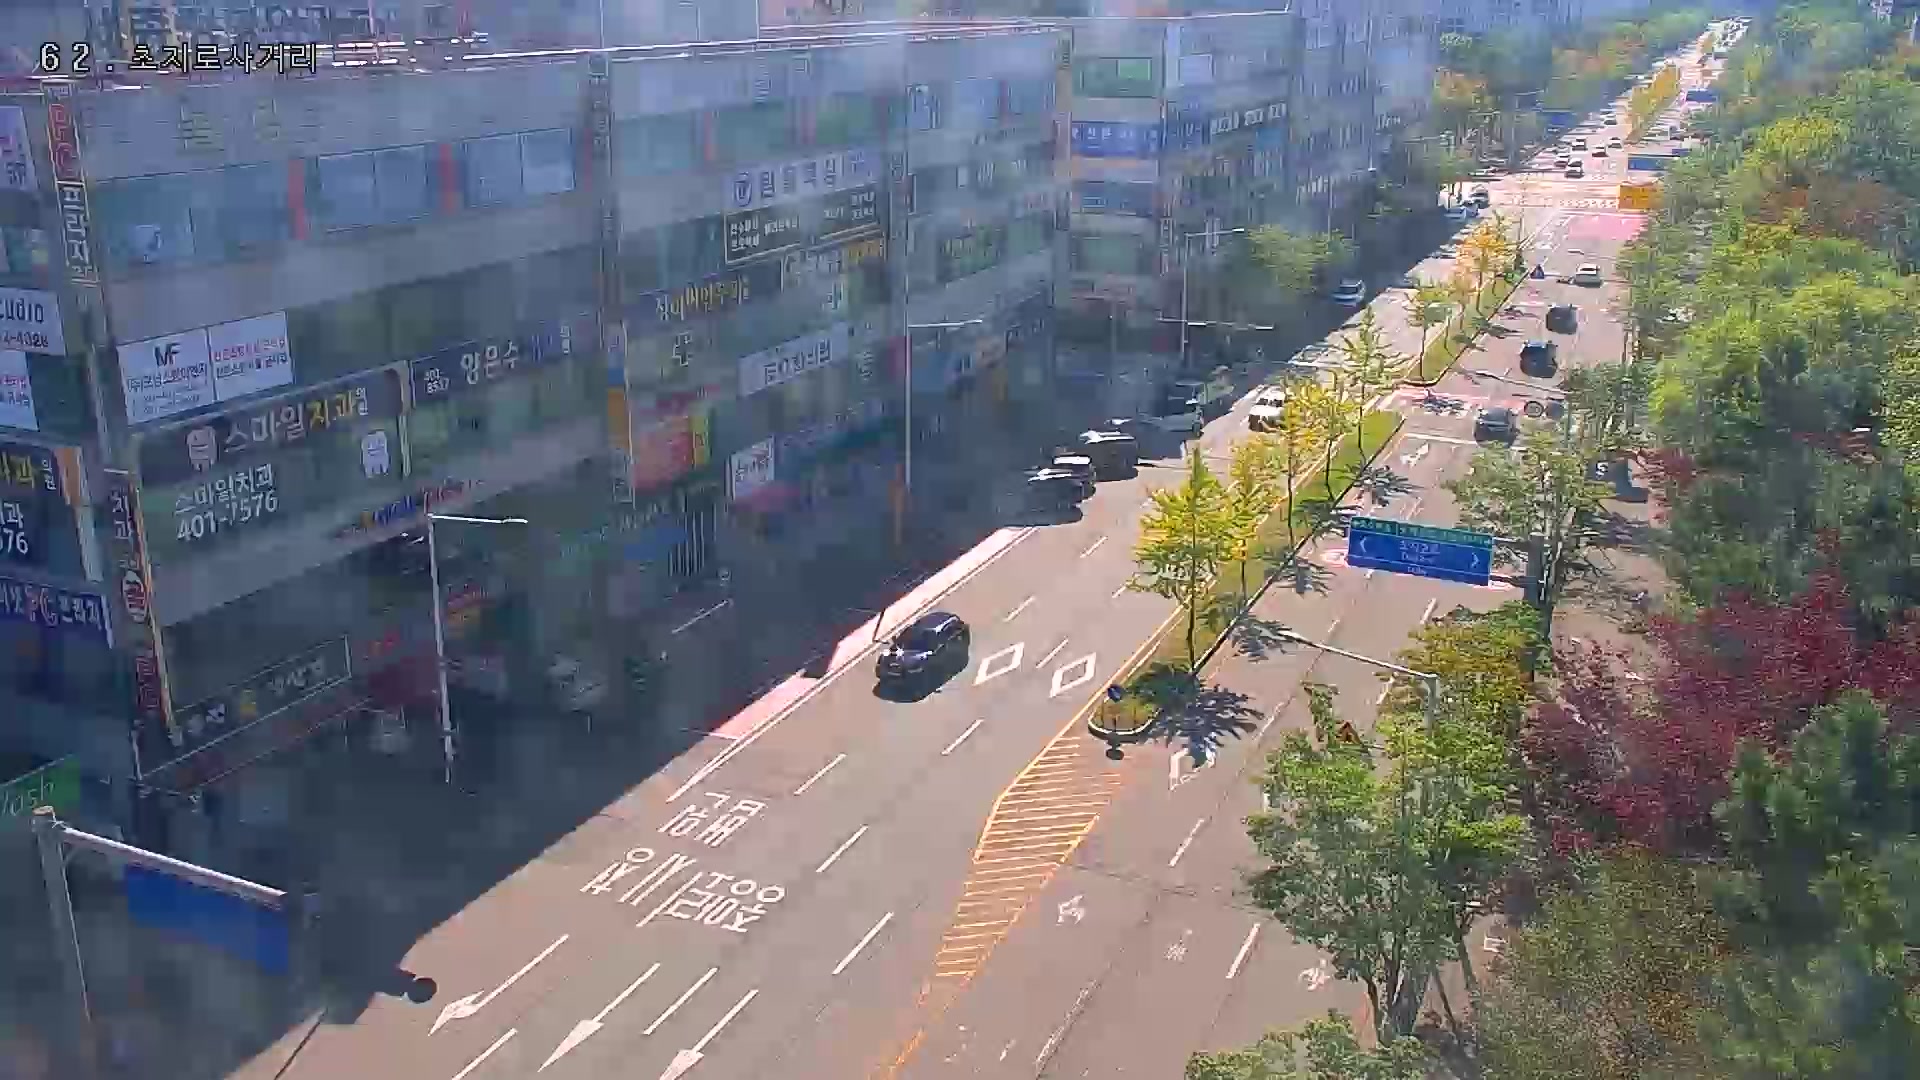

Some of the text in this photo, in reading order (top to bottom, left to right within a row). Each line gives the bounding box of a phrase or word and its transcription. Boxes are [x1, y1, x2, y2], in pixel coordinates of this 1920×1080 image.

[176, 463, 275, 515] 스마일치과
[0, 502, 23, 529] 과
[0, 528, 29, 555] 76
[0, 774, 56, 817] ash
